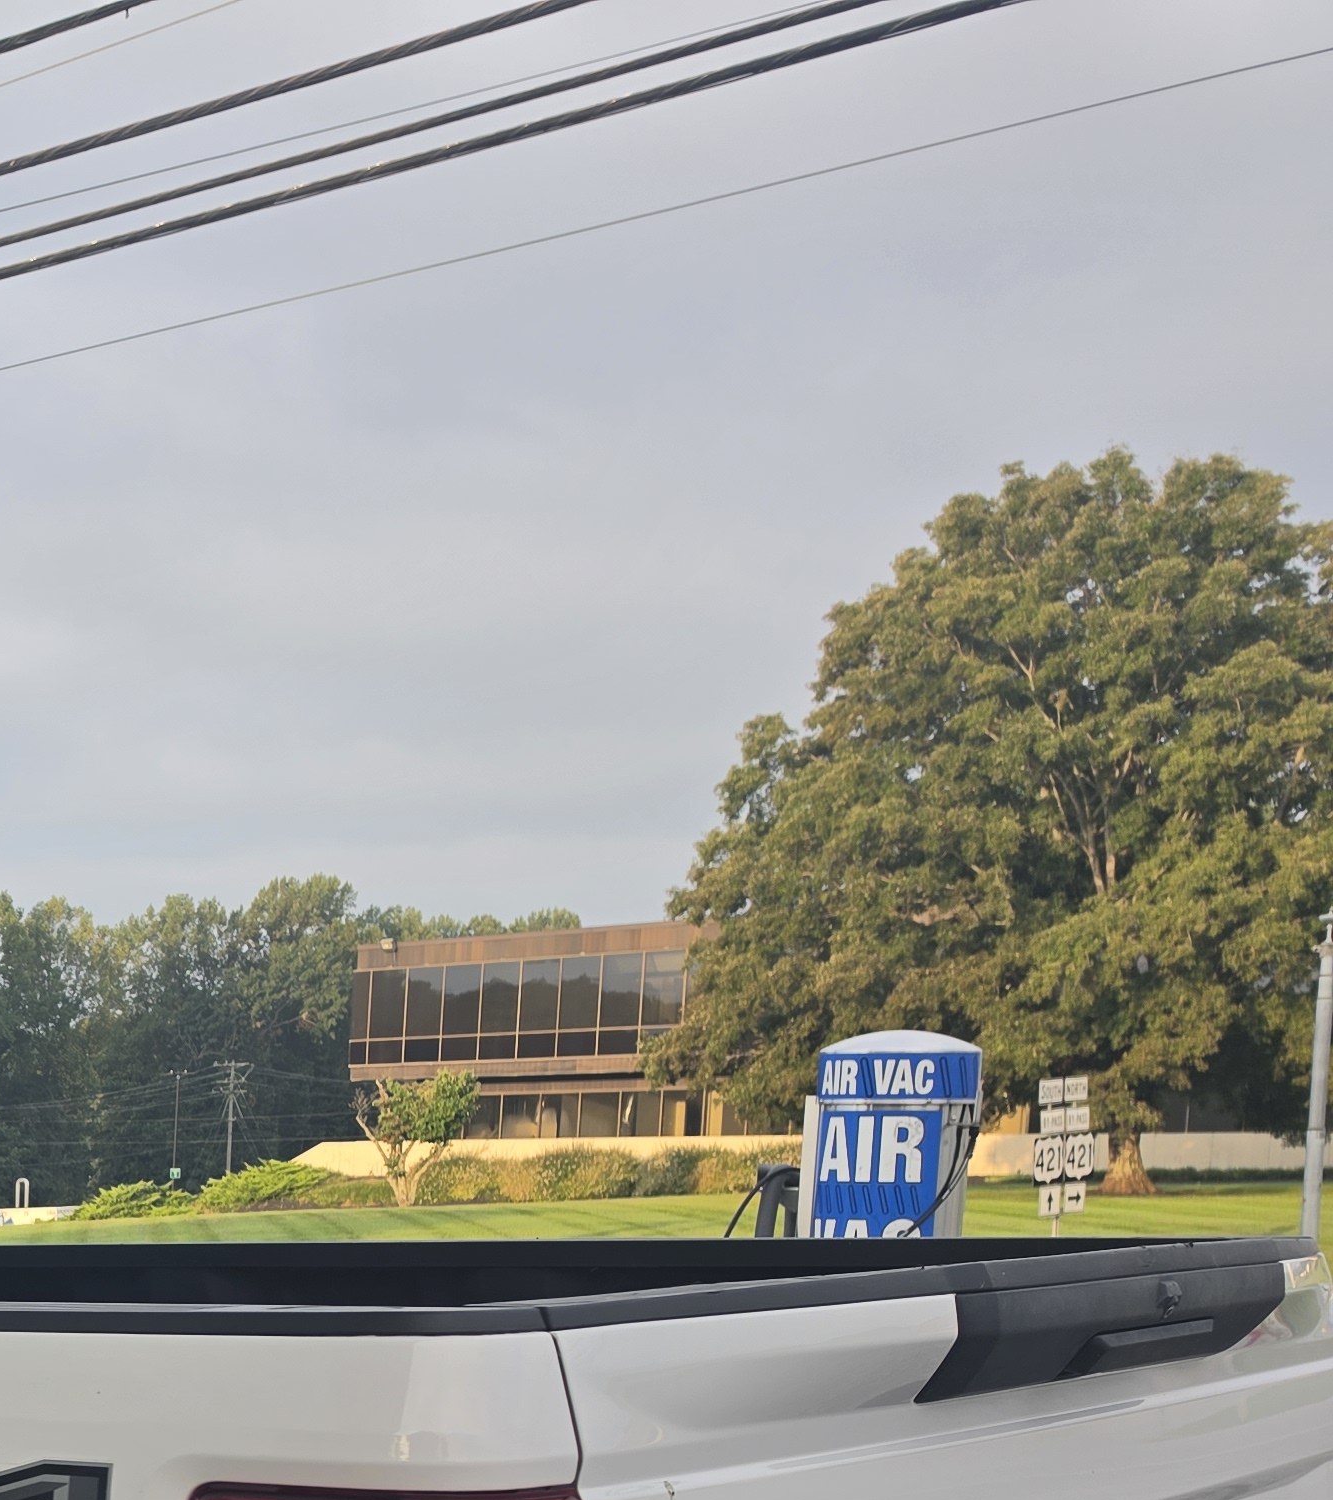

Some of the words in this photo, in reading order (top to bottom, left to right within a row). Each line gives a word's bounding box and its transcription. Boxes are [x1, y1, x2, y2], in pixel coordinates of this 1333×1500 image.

[821, 1059, 859, 1096] AIR
[873, 1058, 935, 1096] VAC
[1066, 1081, 1086, 1097] NORTH
[1041, 1084, 1062, 1100] SOUTH
[819, 1116, 925, 1183] AIR
[1035, 1145, 1062, 1174] 421
[1067, 1142, 1092, 1171] 421
